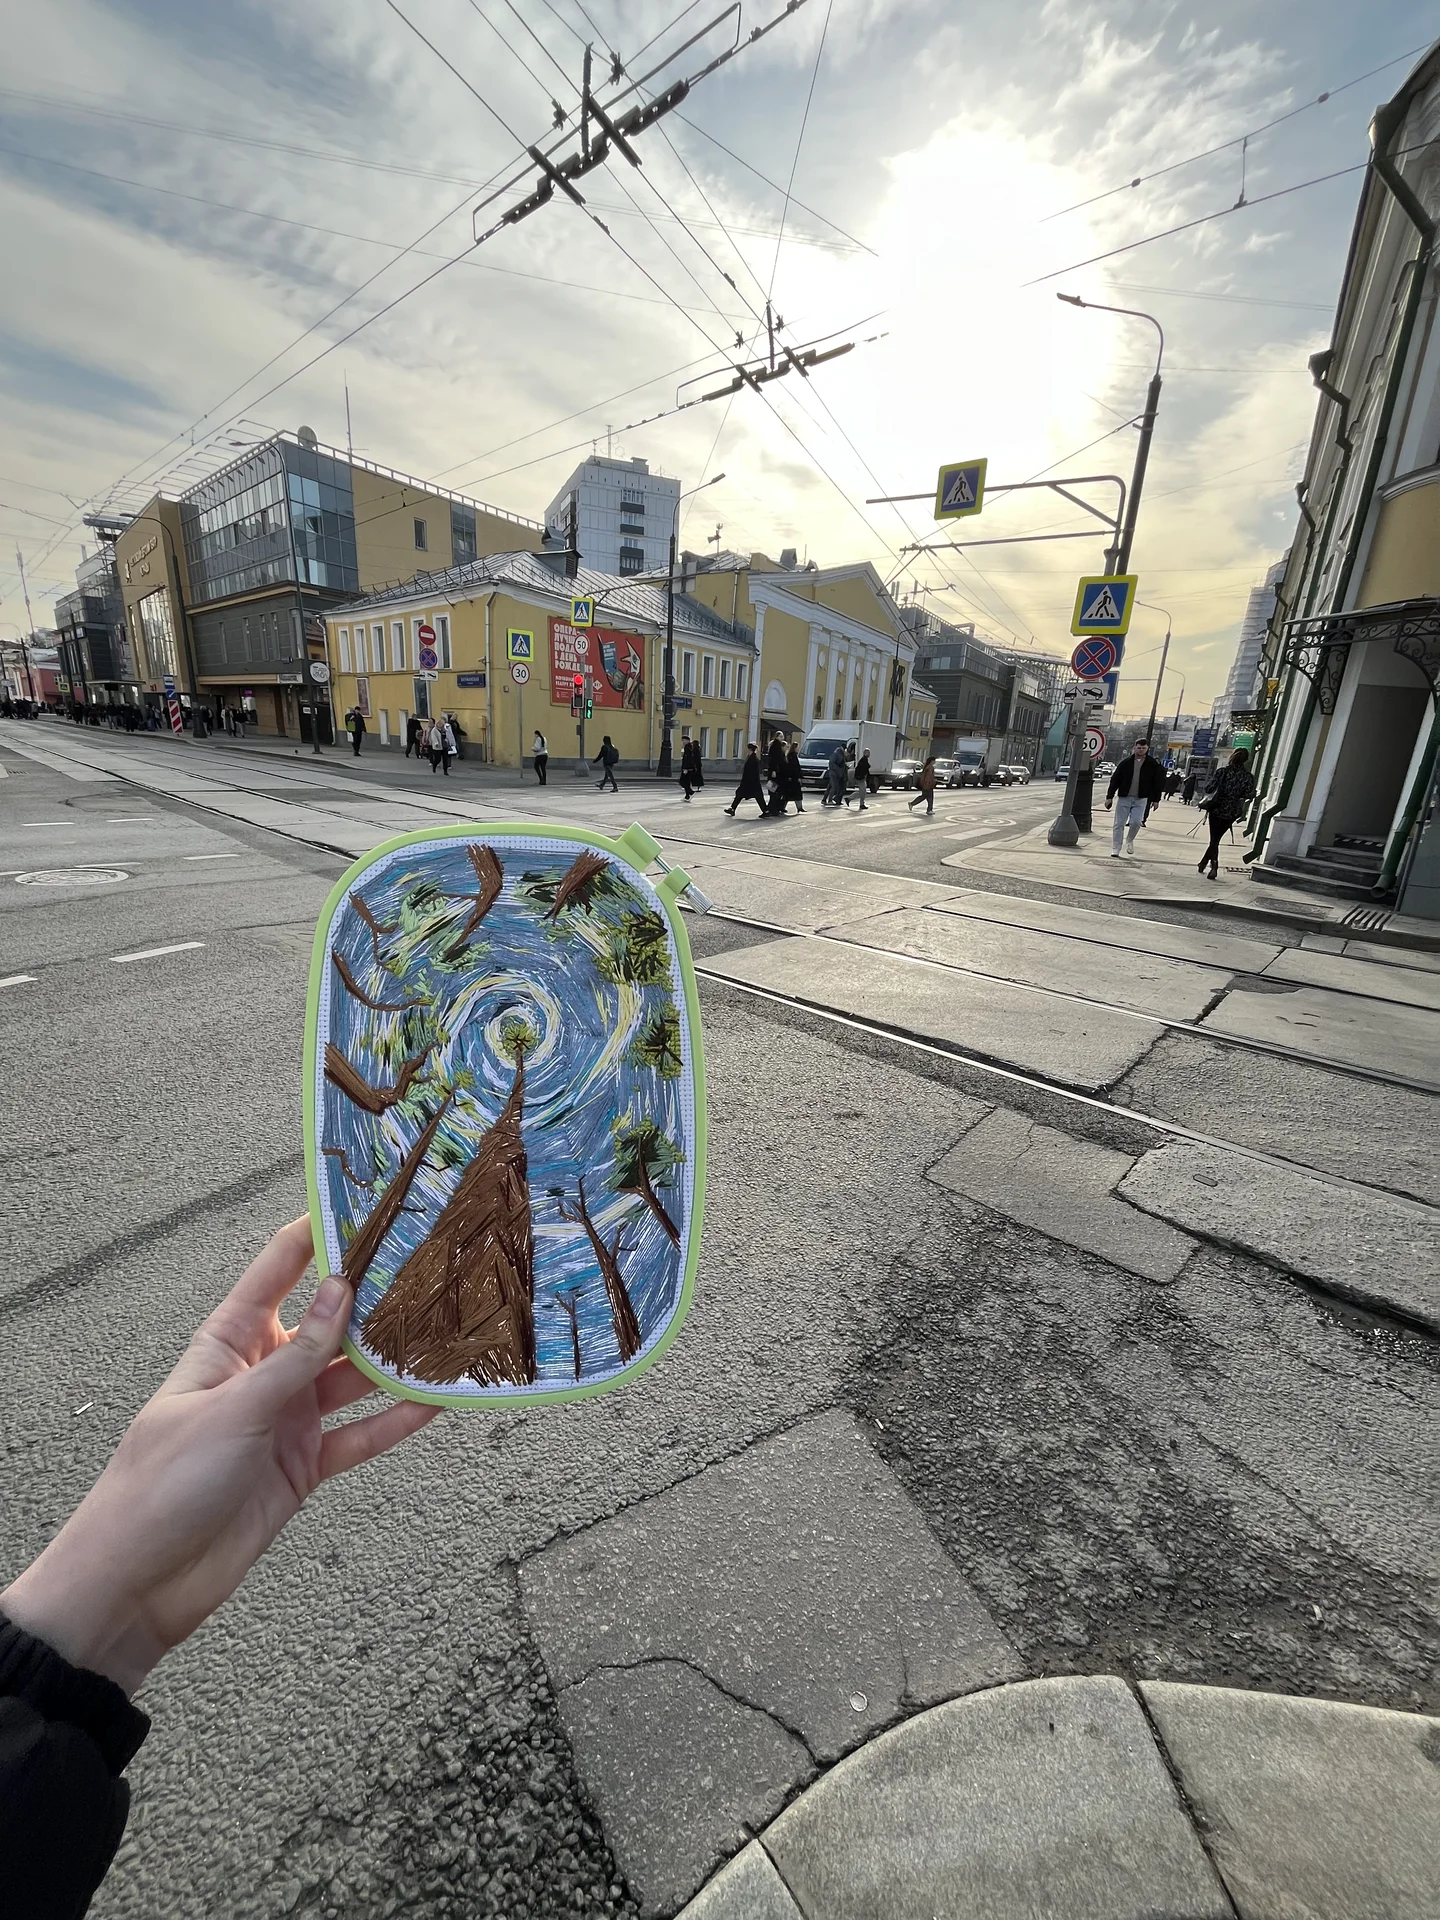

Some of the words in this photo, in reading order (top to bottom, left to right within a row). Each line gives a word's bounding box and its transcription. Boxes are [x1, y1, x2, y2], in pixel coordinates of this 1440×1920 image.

[554, 632, 576, 644] ЛУЧШ
[577, 640, 586, 650] 50
[560, 652, 577, 662] ДЕНЬ
[555, 660, 593, 673] РОЖДЕИЯ
[515, 668, 526, 679] 30
